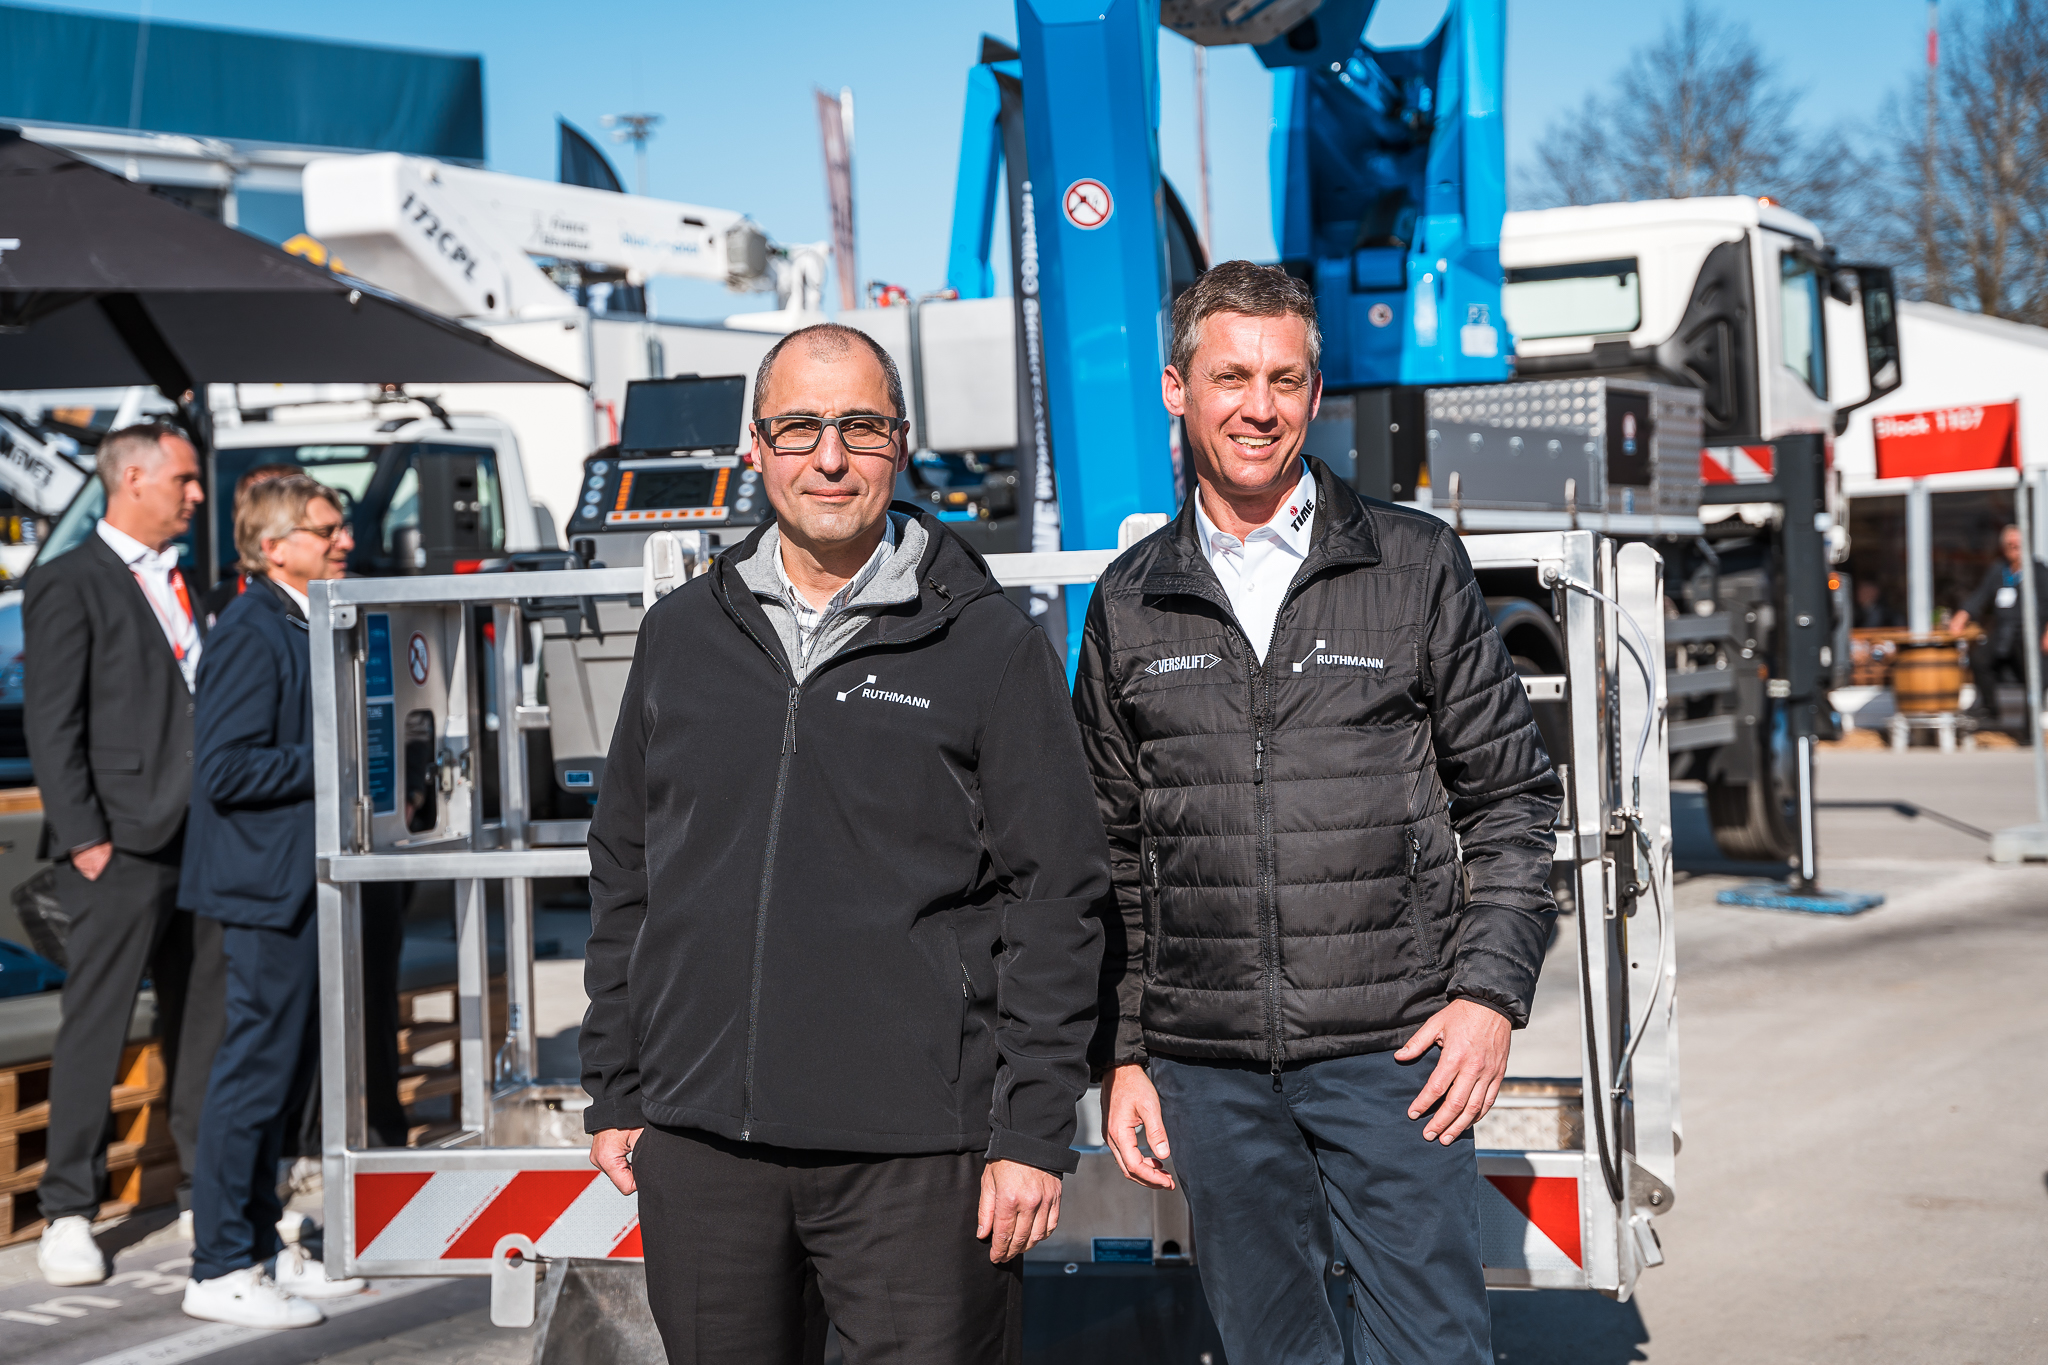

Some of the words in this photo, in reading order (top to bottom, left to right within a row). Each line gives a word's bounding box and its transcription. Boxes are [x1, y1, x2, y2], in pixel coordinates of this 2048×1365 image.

[1291, 498, 1315, 532] TIME
[1157, 653, 1206, 674] VERSALIFT
[1316, 654, 1384, 669] RUTHMANN
[862, 688, 930, 709] RUTHMANN
